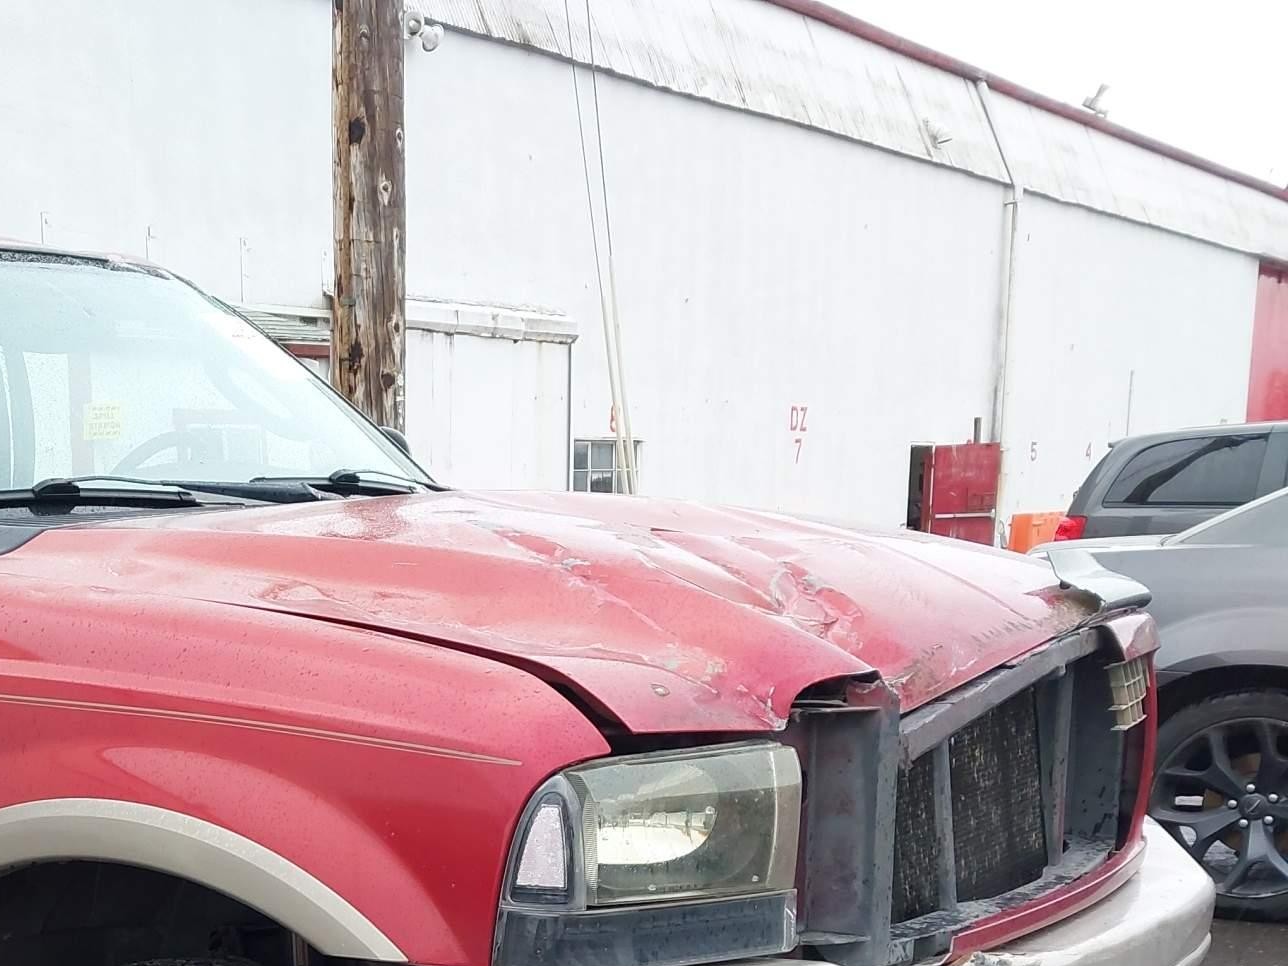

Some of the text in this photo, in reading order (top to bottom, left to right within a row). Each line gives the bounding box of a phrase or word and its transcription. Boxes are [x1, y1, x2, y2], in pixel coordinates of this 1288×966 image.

[790, 406, 808, 432] DZ
[794, 438, 802, 465] 7
[1030, 441, 1038, 462] 5
